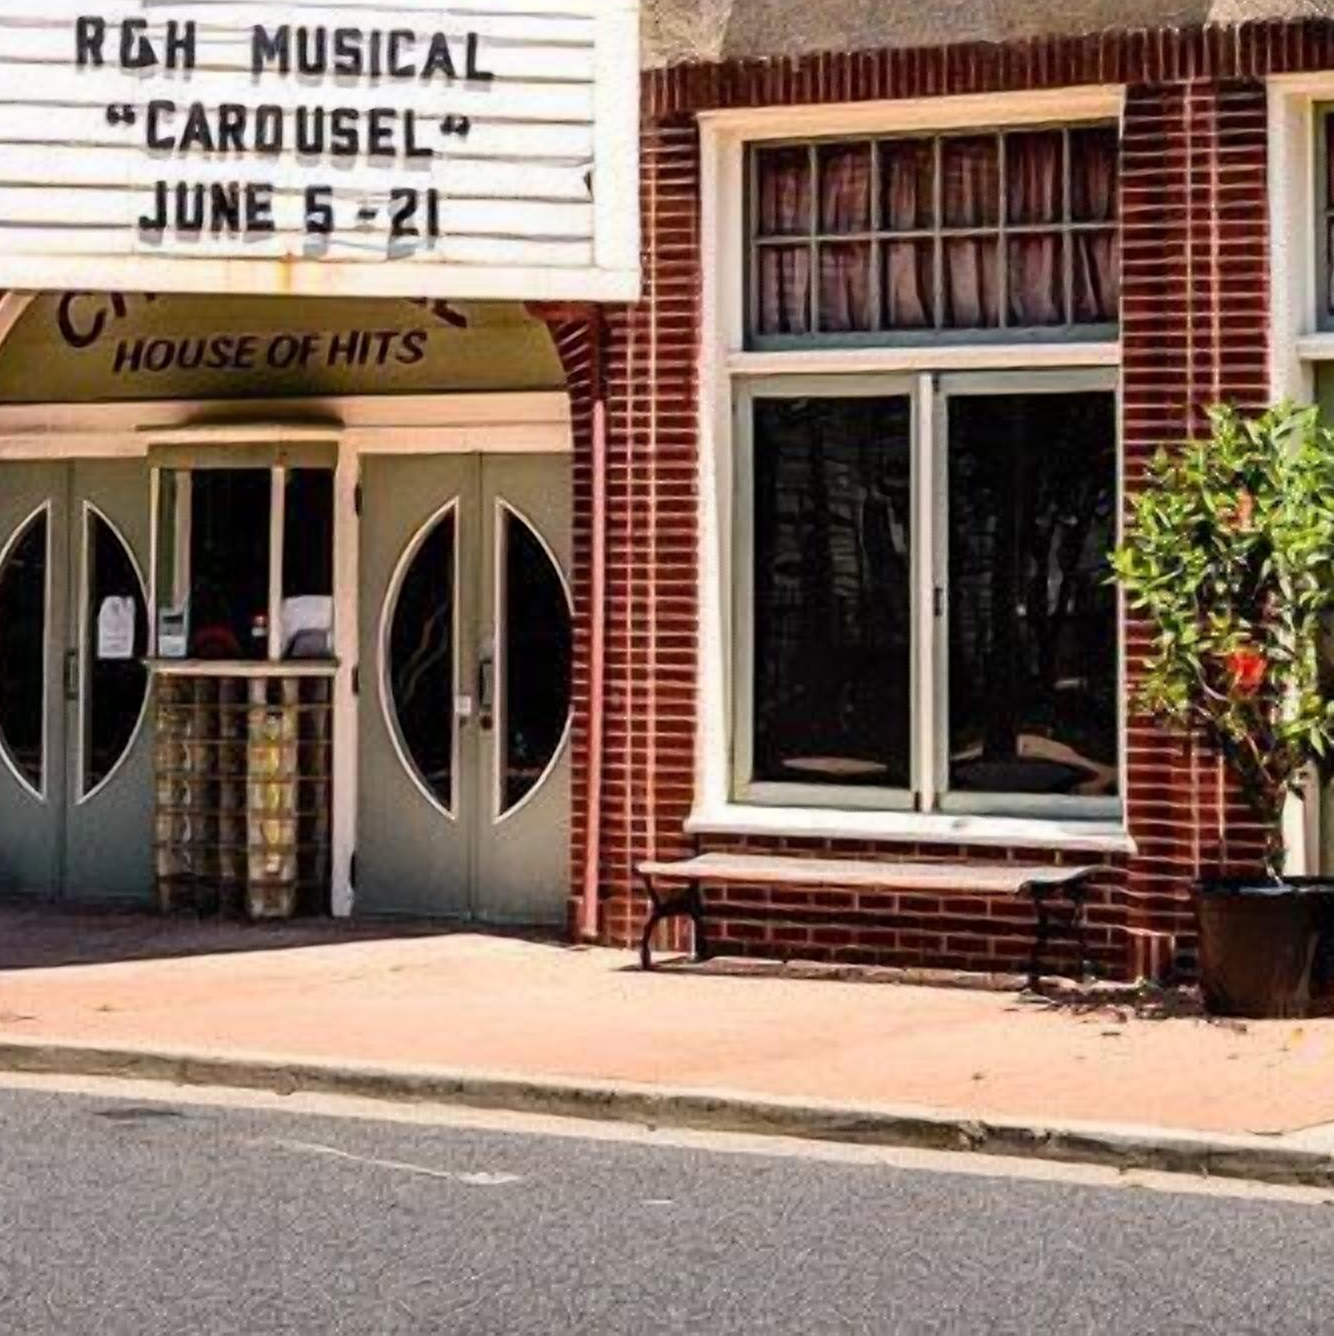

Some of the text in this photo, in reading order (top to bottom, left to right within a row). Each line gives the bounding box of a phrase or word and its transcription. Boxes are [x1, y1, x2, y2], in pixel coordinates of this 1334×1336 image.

[75, 16, 494, 81] R&H MUSICAL
[137, 180, 274, 234] JUNE
[111, 330, 429, 374] HOUSE OF HITS
